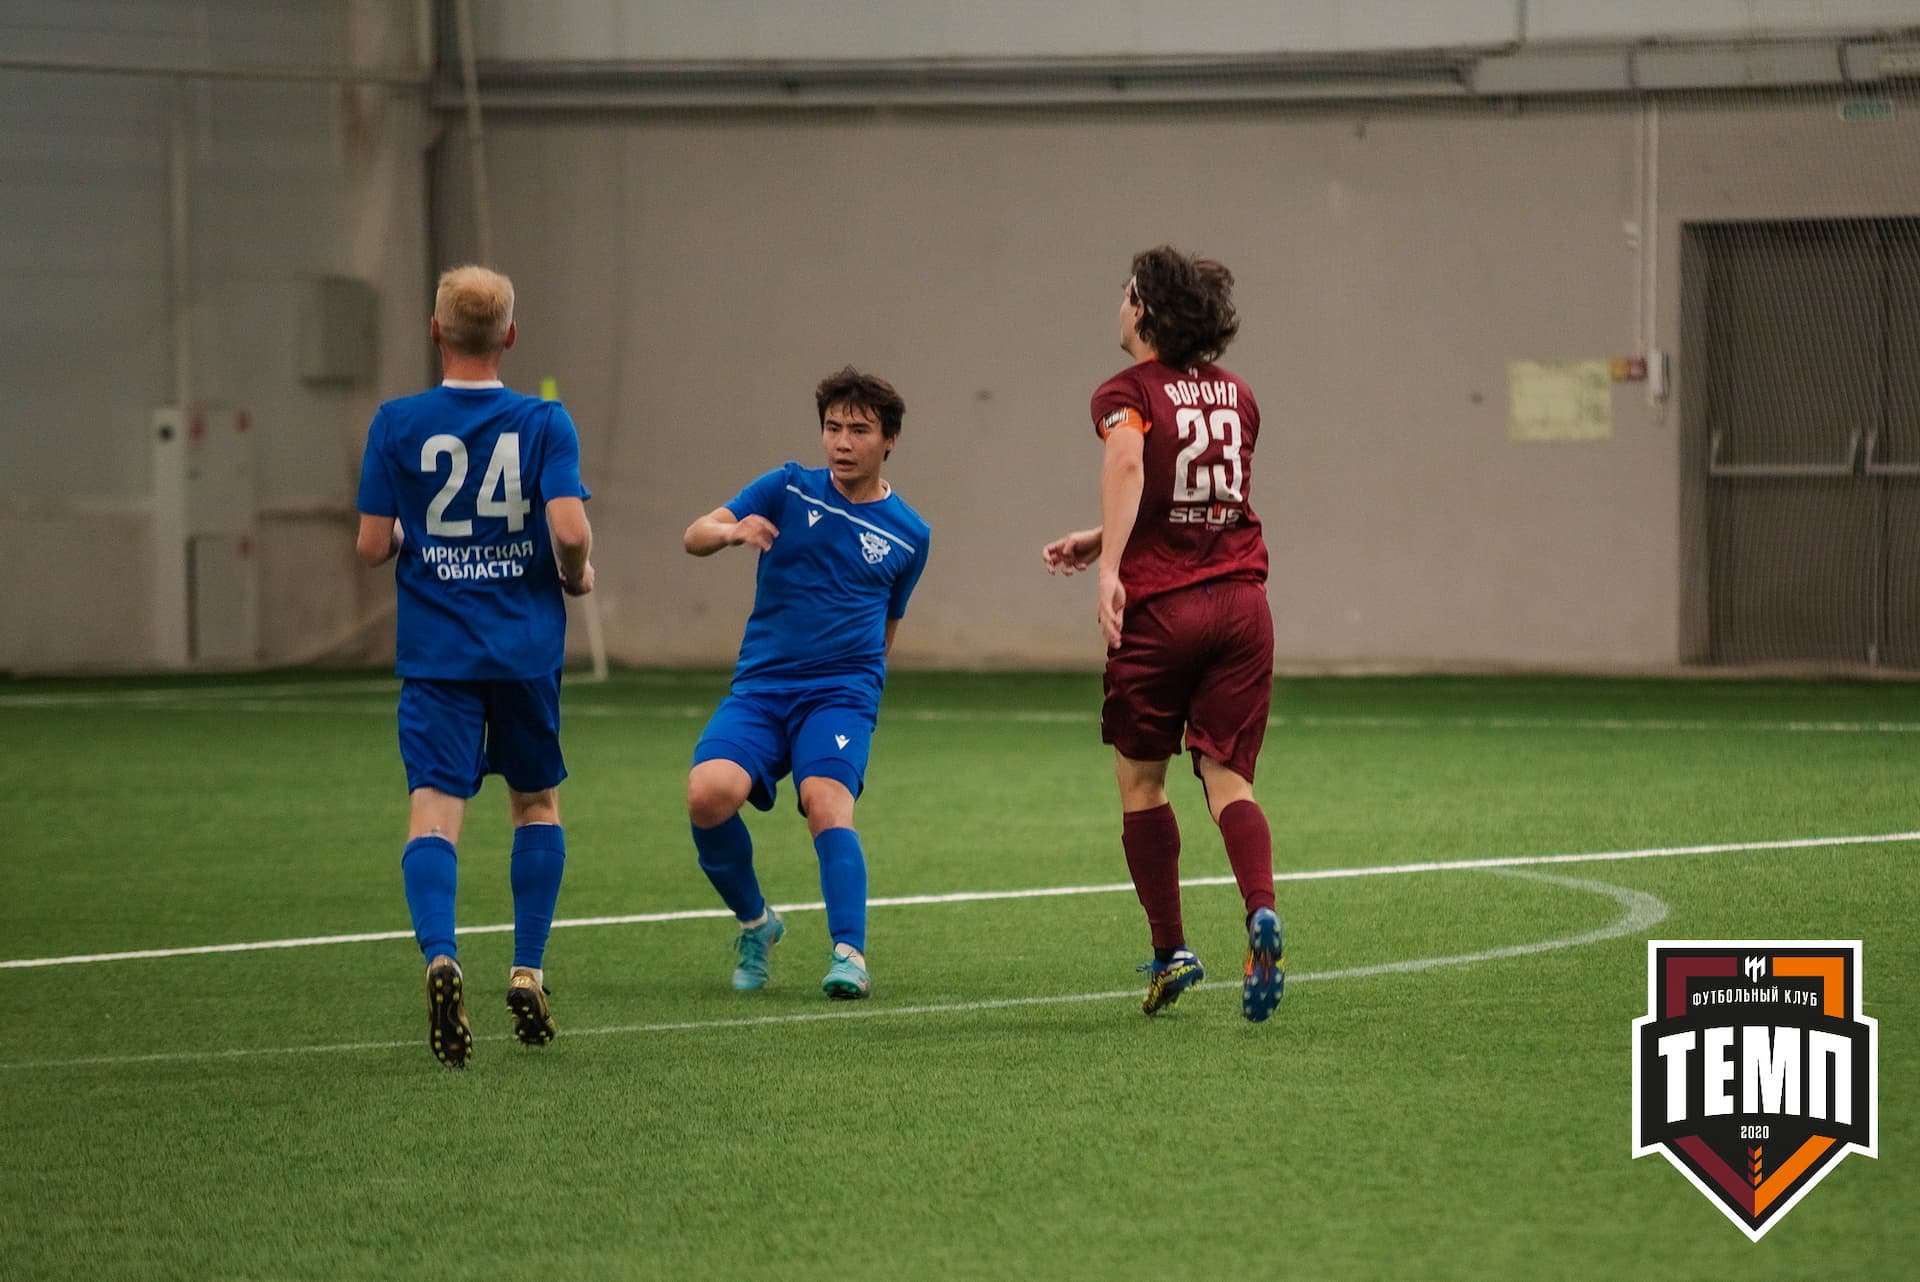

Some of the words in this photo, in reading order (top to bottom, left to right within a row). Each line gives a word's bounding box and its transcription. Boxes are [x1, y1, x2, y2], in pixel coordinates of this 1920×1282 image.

[1164, 380, 1238, 408] ВОРОНА
[1173, 407, 1243, 502] 23
[420, 432, 531, 537] 24
[1168, 505, 1243, 524] SEUS
[421, 540, 534, 564] ИРКУТСКАЯ
[437, 559, 524, 581] ОБЛАСТЬ
